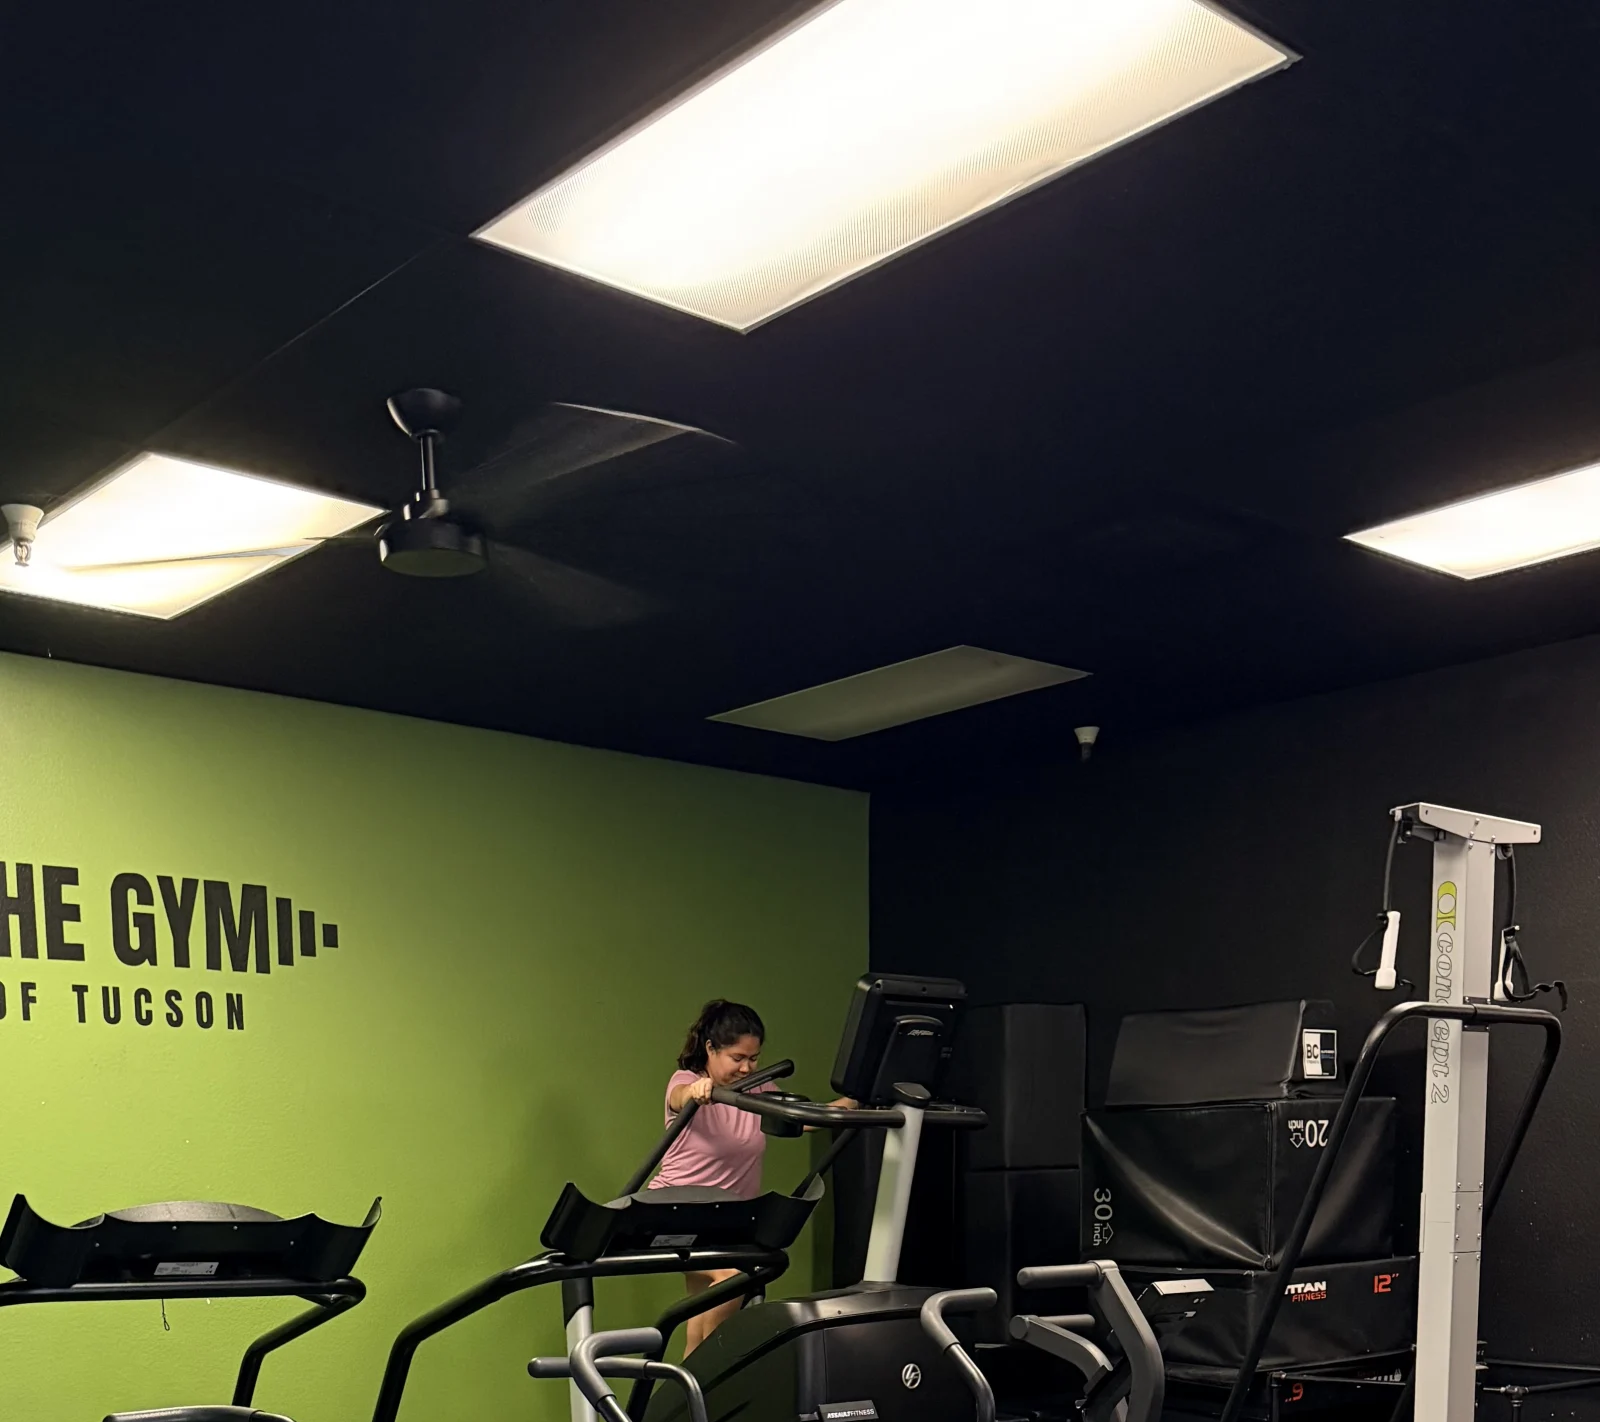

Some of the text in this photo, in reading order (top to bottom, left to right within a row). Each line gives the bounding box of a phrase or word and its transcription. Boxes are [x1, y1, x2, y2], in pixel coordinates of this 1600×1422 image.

[110, 872, 271, 974] GYM
[71, 984, 245, 1031] TUCSON
[1430, 931, 1454, 1105] conept 2
[1306, 1044, 1319, 1060] BC
[1288, 1119, 1329, 1148] 20 inch
[1093, 1188, 1113, 1246] 30 inch
[1292, 1291, 1327, 1303] FITNESS
[827, 1408, 875, 1419] ASSAULTFITNESS
